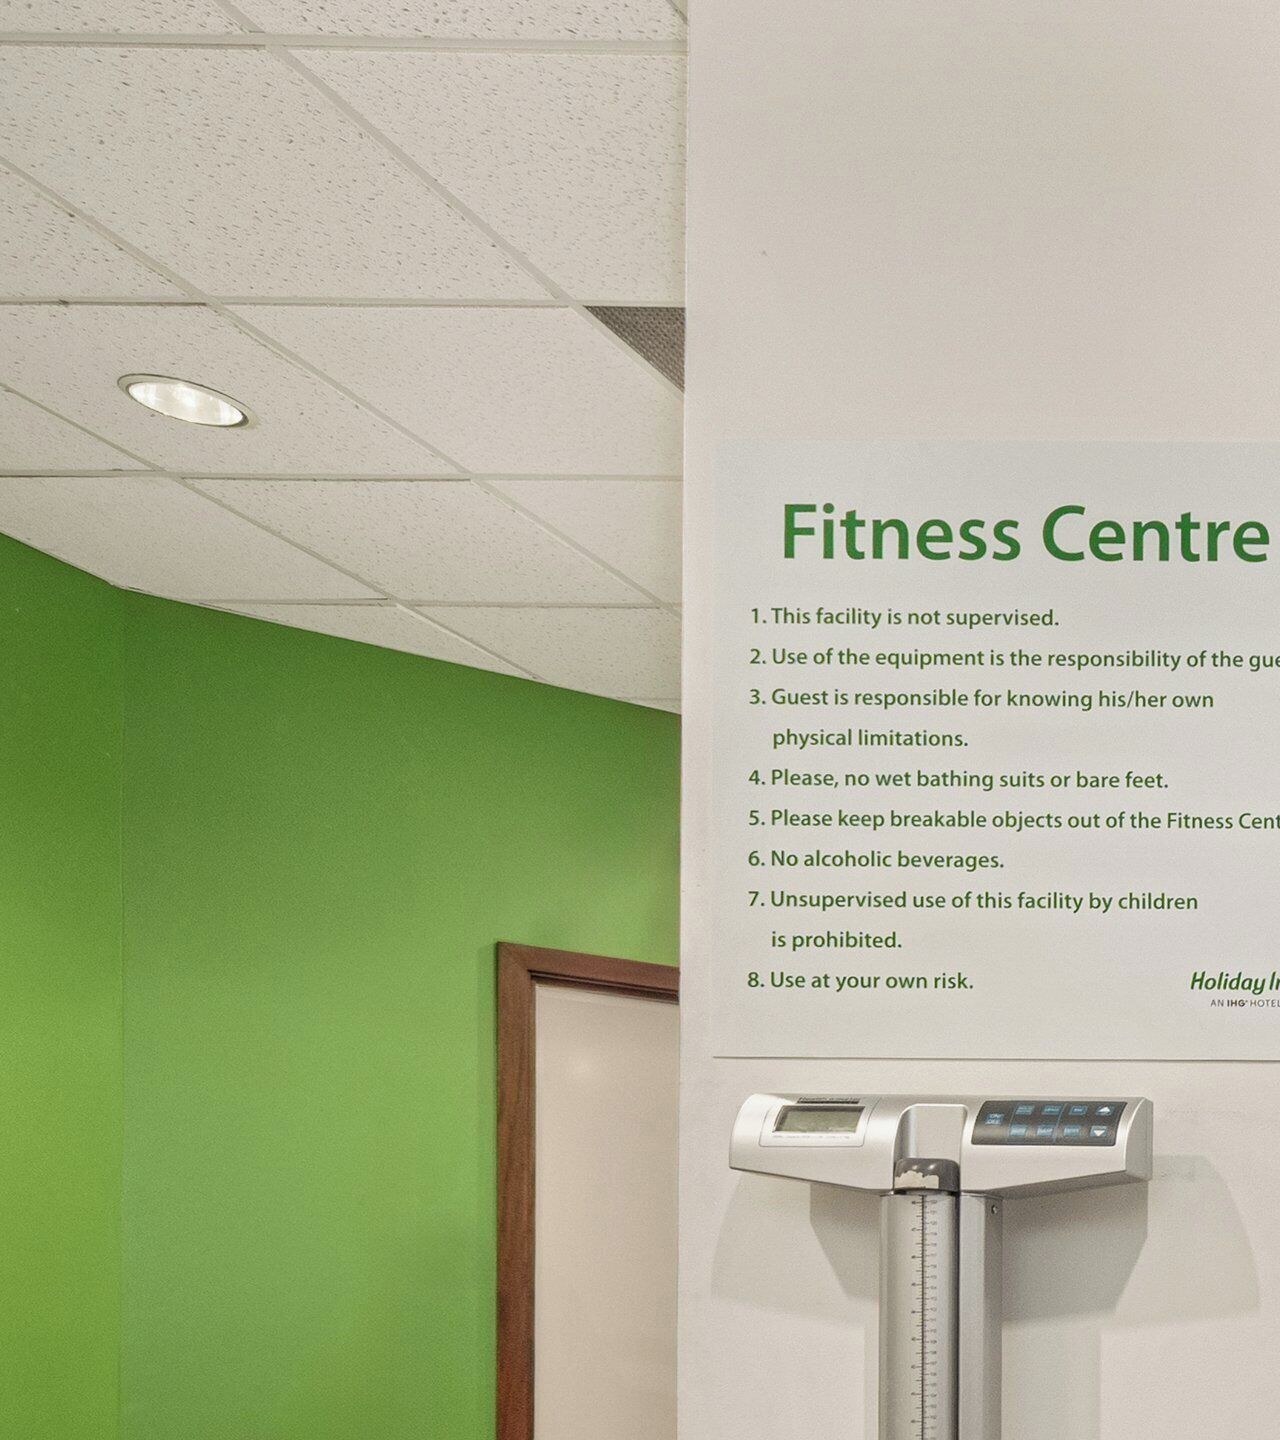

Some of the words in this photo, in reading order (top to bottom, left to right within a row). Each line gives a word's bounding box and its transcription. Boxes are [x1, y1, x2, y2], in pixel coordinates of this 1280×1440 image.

[783, 502, 1022, 562] Fitness
[1042, 504, 1270, 564] Centre
[751, 607, 767, 624] 1.
[770, 606, 812, 625] This
[815, 606, 883, 630] facility
[887, 607, 903, 625] is
[907, 610, 942, 626] not
[946, 608, 1060, 630] supervised.
[749, 648, 767, 665] 2.
[772, 647, 808, 665] Use
[812, 647, 834, 665] of
[837, 647, 871, 666] the
[875, 648, 985, 670] equipment
[990, 649, 1005, 667] is
[1009, 648, 1043, 667] the
[1047, 649, 1182, 672] responsibility
[1186, 649, 1208, 668] of
[1210, 650, 1244, 668] the
[748, 688, 767, 705] 3.
[771, 688, 829, 706] Guest
[834, 688, 849, 706] is
[854, 688, 969, 711] responsible
[973, 688, 1002, 707] for
[1006, 689, 1093, 712] knowing
[1098, 689, 1168, 709] his/her
[1171, 695, 1214, 708] own
[773, 728, 853, 751] physical
[858, 728, 969, 747] limitations.
[748, 769, 766, 786] 4.
[771, 768, 839, 789] Please,
[844, 773, 870, 787] no
[874, 771, 912, 787] wet
[917, 769, 994, 792] bathing
[999, 770, 1045, 788] suits
[1049, 775, 1072, 788] or
[1076, 770, 1121, 789] bare
[1124, 770, 1169, 789] feet.
[748, 809, 766, 826] 5.
[771, 808, 833, 827] Please
[838, 808, 885, 832] keep
[890, 809, 988, 828] breakable
[991, 810, 1063, 833] objects
[1067, 813, 1101, 829] out
[1105, 810, 1126, 829] of
[1129, 811, 1162, 829] the
[1167, 811, 1234, 830] Fitness
[747, 850, 766, 867] 6.
[771, 849, 799, 867] No
[803, 849, 892, 868] alcoholic
[897, 849, 1005, 873] beverages.
[747, 890, 765, 907] 7.
[770, 890, 907, 912] Unsupervised
[912, 895, 947, 909] use
[951, 890, 973, 909] of
[975, 891, 1013, 909] this
[1016, 891, 1084, 914] facility
[1088, 891, 1114, 914] by
[1117, 891, 1198, 910] children
[771, 930, 787, 948] is
[792, 930, 903, 952] prohibited.
[747, 971, 766, 988] 8.
[770, 971, 807, 989] Use
[810, 973, 831, 989] at
[835, 975, 881, 993] your
[885, 976, 928, 989] own
[933, 971, 974, 990] risk.
[1190, 971, 1266, 995] Holiday
[1210, 999, 1224, 1008] AN
